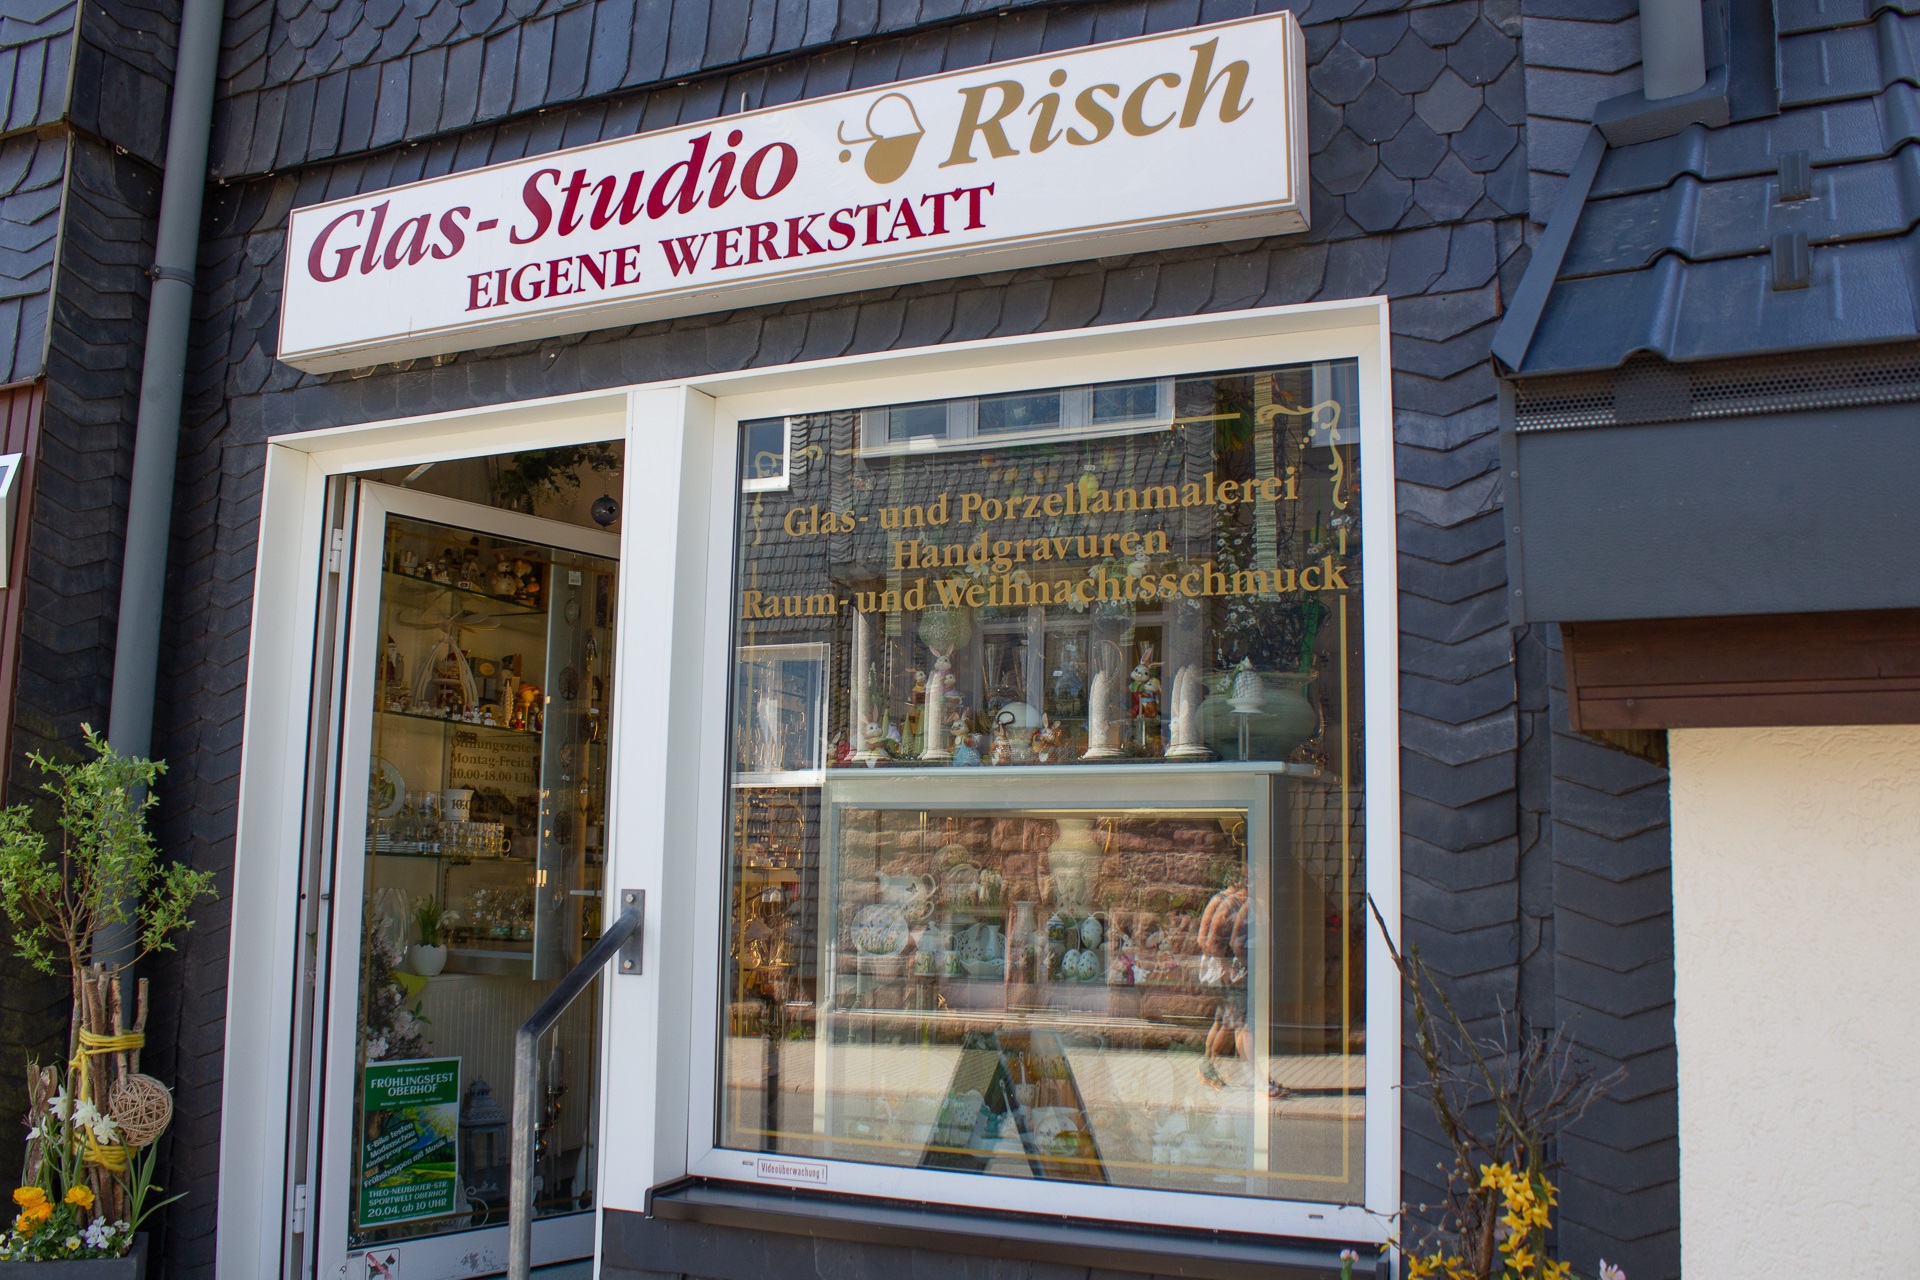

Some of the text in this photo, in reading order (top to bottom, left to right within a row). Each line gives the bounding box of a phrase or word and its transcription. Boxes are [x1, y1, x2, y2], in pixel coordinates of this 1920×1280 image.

[938, 37, 1254, 169] Risch
[465, 182, 995, 312] EIGENE WERKSTATT
[784, 466, 1299, 537] Glas- und Porzellanmalerei
[892, 530, 1169, 573] Handgravuren
[742, 555, 1349, 619] Raum- und Weihnachtsschmuck
[370, 1072, 454, 1089] FRÜHLINGSFEST
[388, 1083, 438, 1097] OBERHOF
[366, 1122, 414, 1151] E-Bike testen
[370, 1130, 416, 1159] Modenschau
[412, 1150, 424, 1162] mit
[425, 1139, 447, 1155] Musik
[367, 1207, 400, 1218] 20.04.
[402, 1203, 414, 1213] ab
[415, 1201, 426, 1210] 10
[428, 1198, 447, 1209] UHR
[368, 1188, 448, 1206] SPORTWELT OBERHOF
